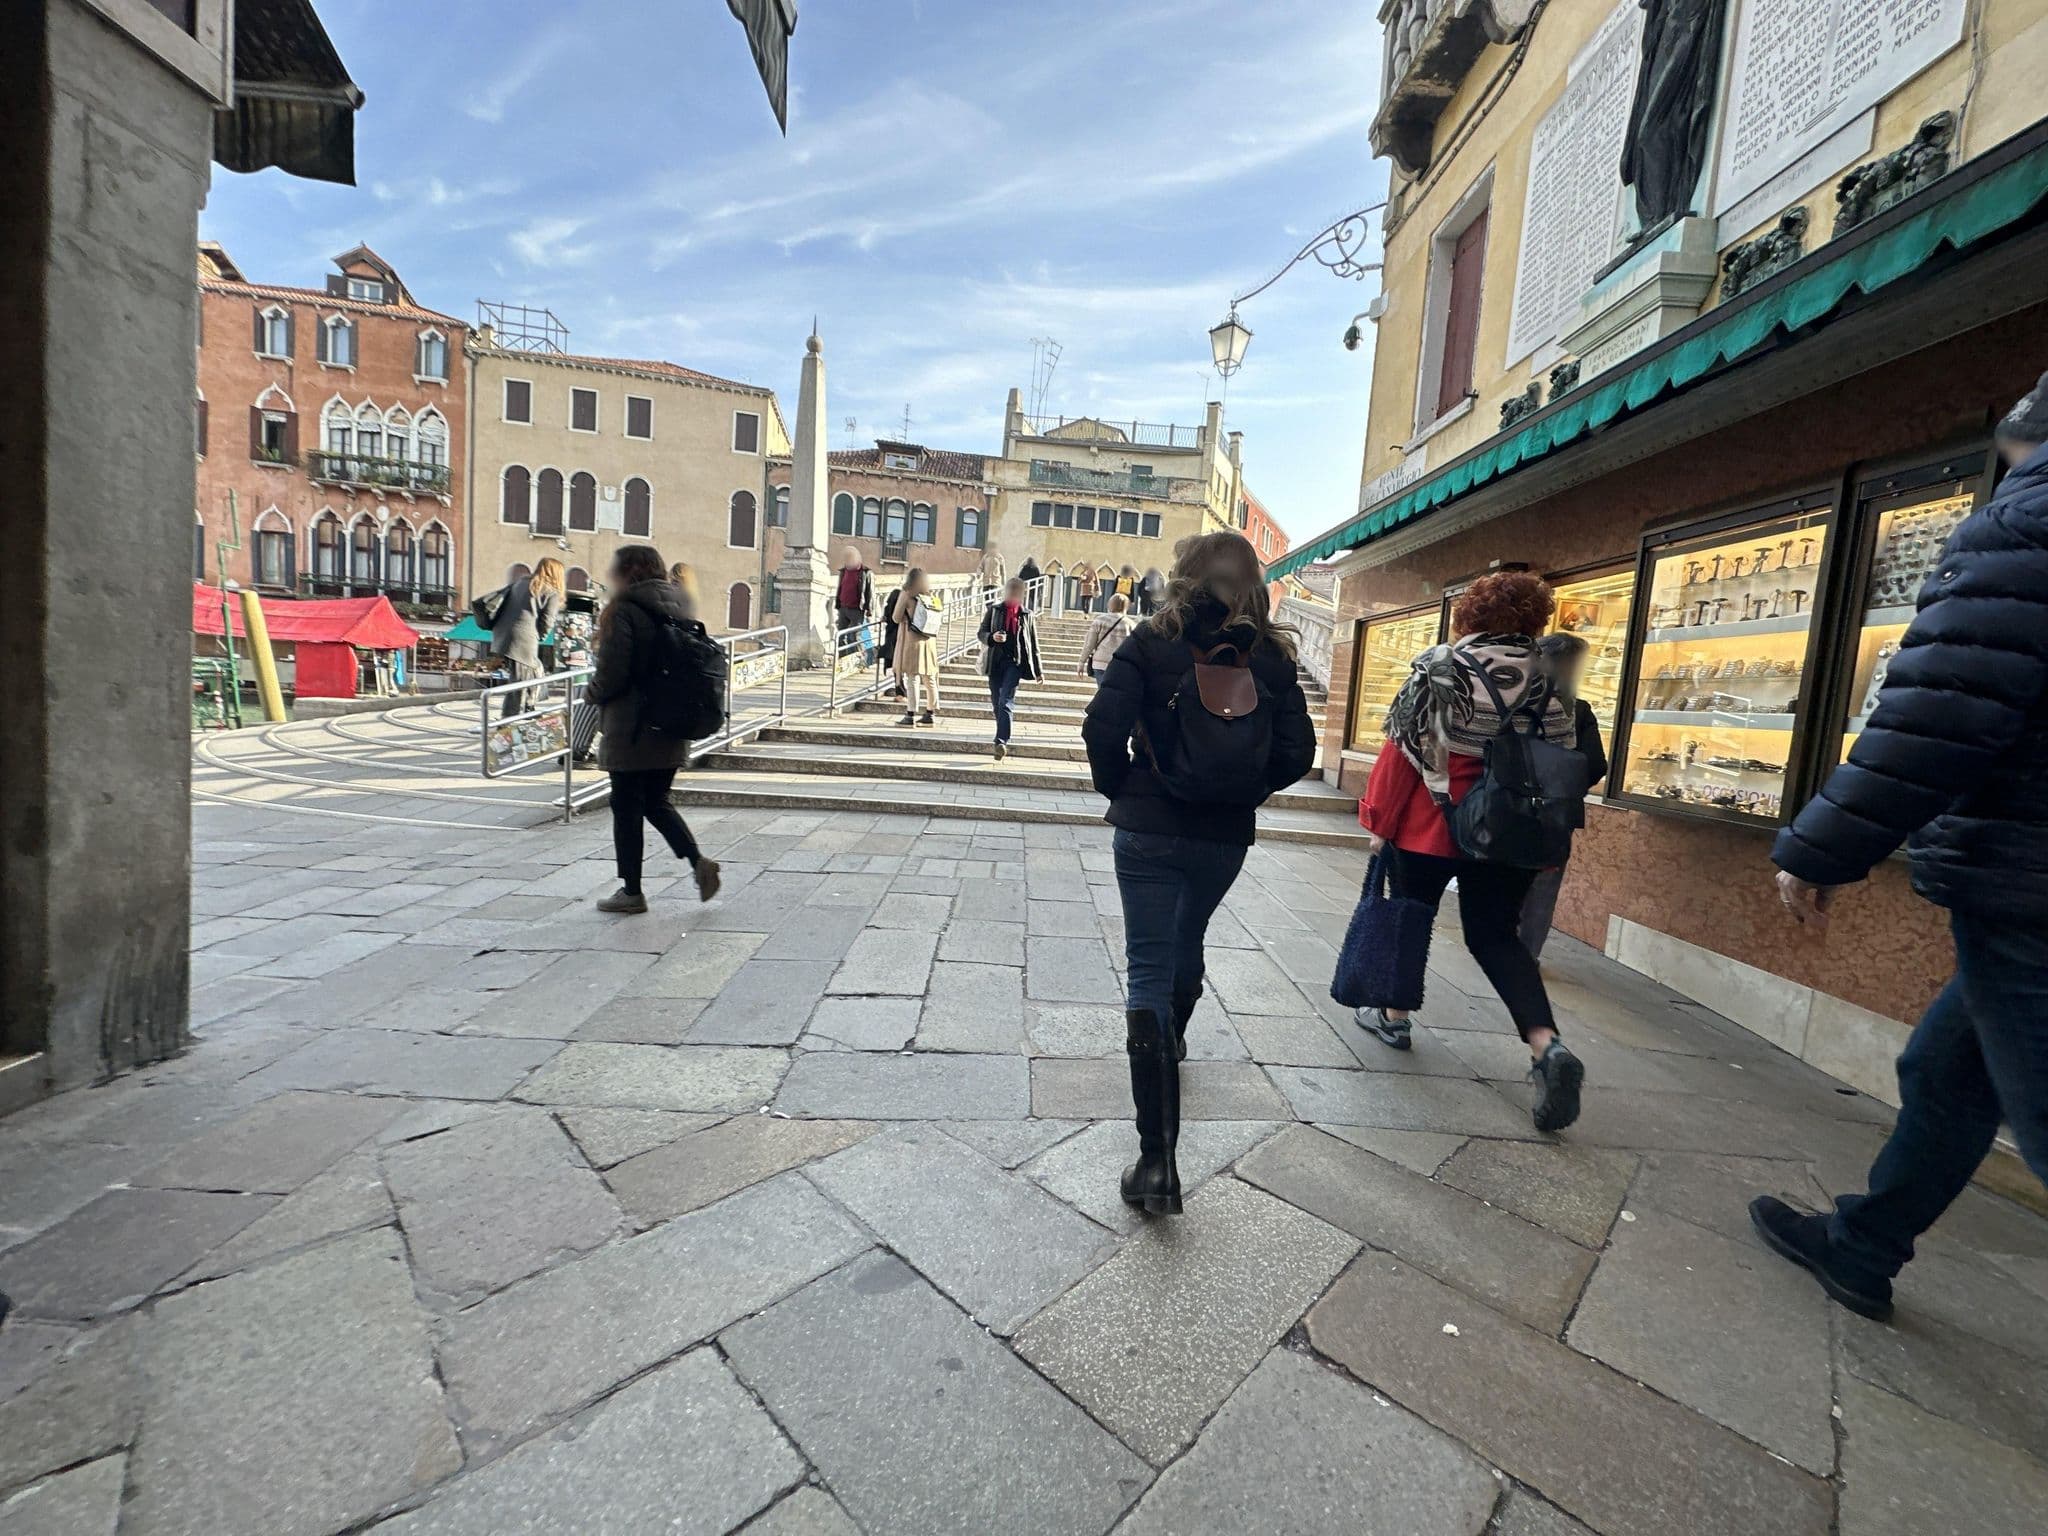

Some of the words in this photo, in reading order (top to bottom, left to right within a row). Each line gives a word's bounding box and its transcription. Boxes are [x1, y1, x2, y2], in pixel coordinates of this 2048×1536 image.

[1741, 54, 1786, 99] ORANDA
[1794, 16, 1829, 53] LUIGI
[1779, 0, 1831, 55] EUGENIO
[1828, 54, 1878, 102] ZOCCHIA
[1891, 6, 1940, 53] MARCO
[1832, 26, 1879, 73] ZENNARO
[1834, 13, 1878, 57] ZAVAGNO
[1738, 91, 1770, 125] PALMA
[1778, 44, 1825, 91] ROMANO
[1739, 86, 1762, 112] OSSI
[1767, 30, 1827, 89] FERRUCCIO
[1780, 59, 1822, 102] GIUSEPPE
[1782, 73, 1821, 112] GIOVANNI
[1830, 38, 1882, 87] ZENNARO
[1731, 141, 1768, 176] POLON
[1775, 102, 1816, 142] DANTE
[1733, 126, 1772, 163] PIGOZZO
[1777, 87, 1819, 129] ANGELO
